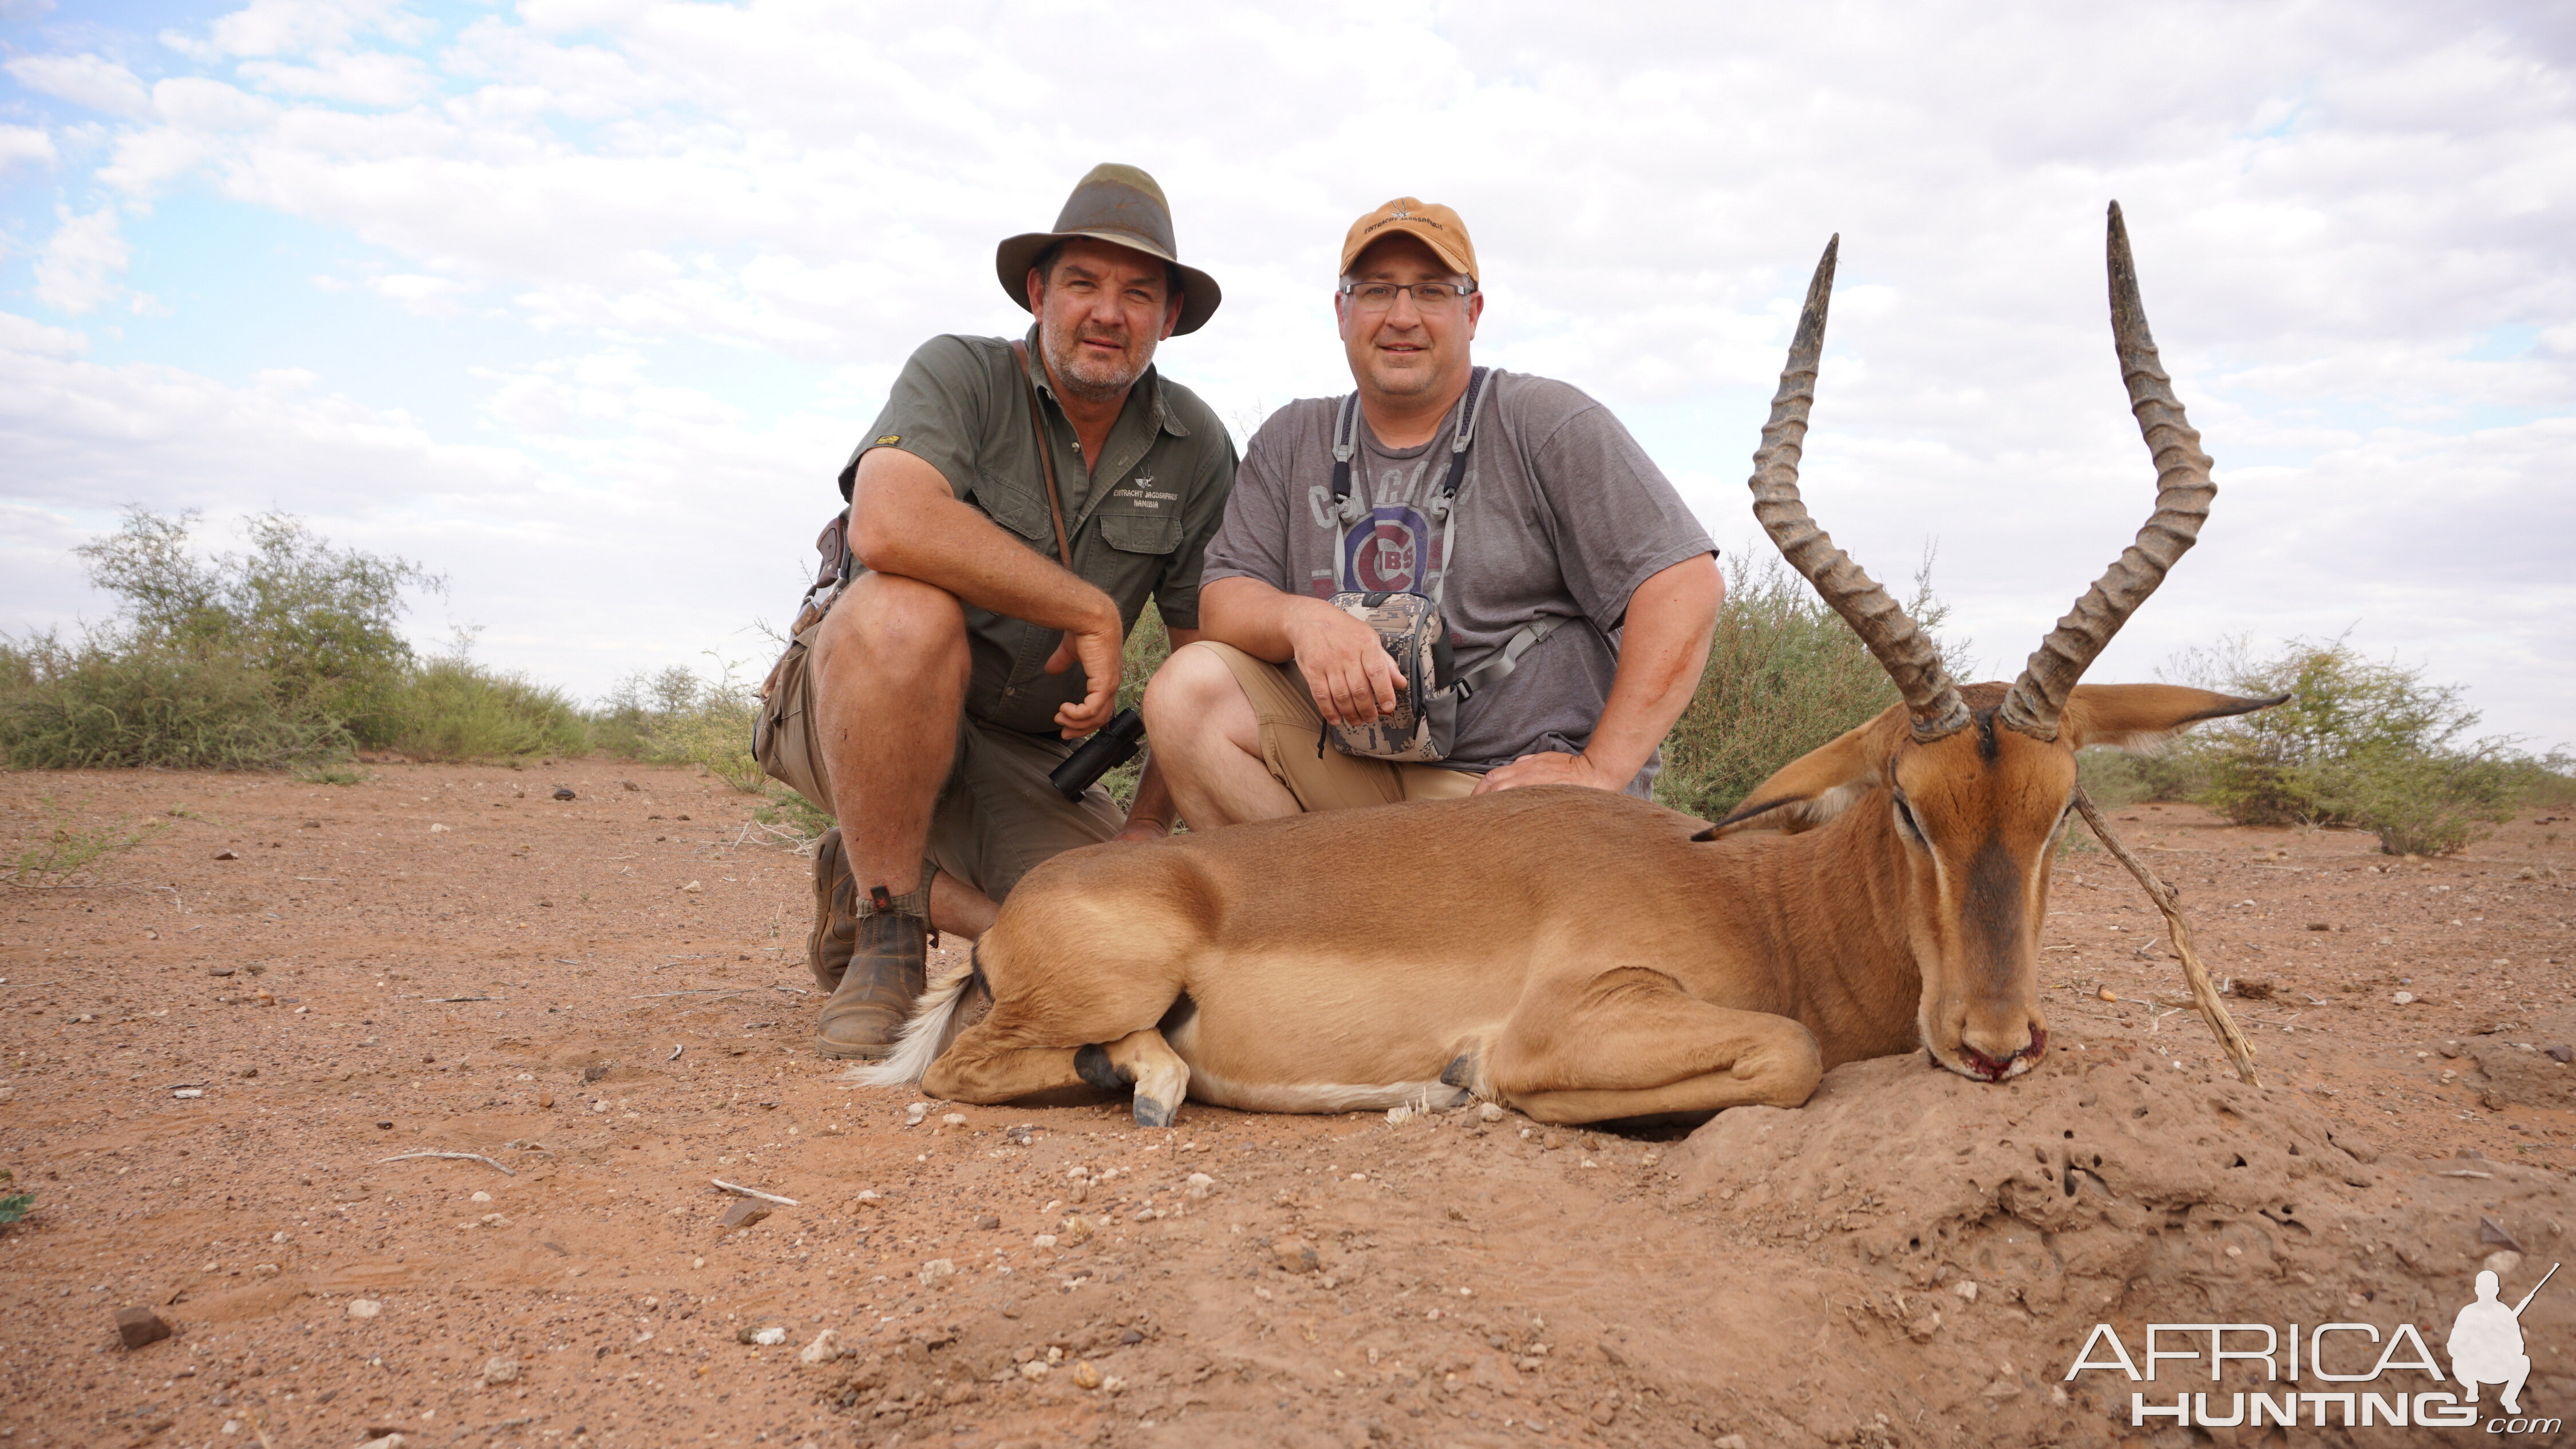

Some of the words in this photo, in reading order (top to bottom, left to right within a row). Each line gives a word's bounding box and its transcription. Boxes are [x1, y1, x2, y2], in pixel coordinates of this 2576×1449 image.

[1364, 217, 1398, 234] EINTRACHT
[1145, 491, 1178, 500] JAGDSAFARIS
[1308, 461, 1477, 529] CCAGO
[1134, 499, 1158, 509] NAMIBIA
